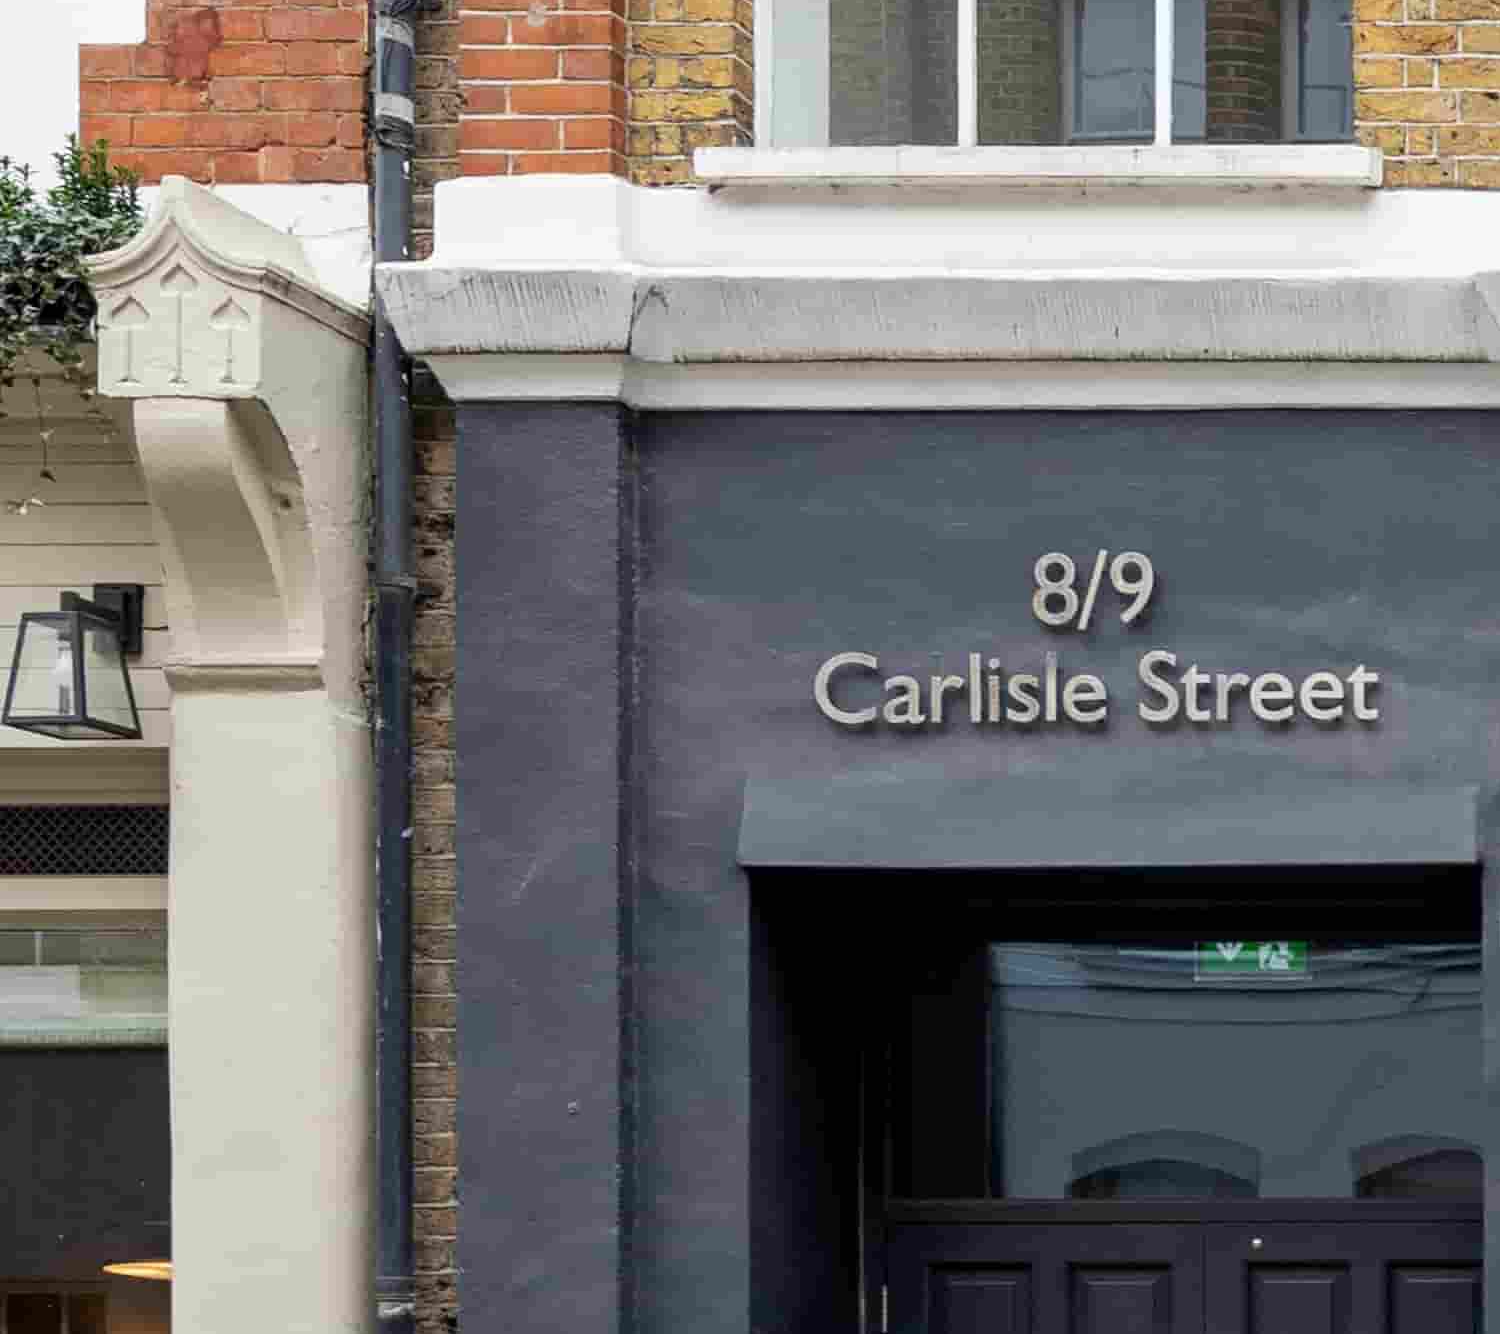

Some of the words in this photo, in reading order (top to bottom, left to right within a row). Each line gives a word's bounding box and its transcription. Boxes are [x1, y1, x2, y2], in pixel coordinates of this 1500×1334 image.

[1031, 548, 1157, 631] 8/9
[812, 650, 1109, 725] Carlisle
[1137, 650, 1381, 723] Street
